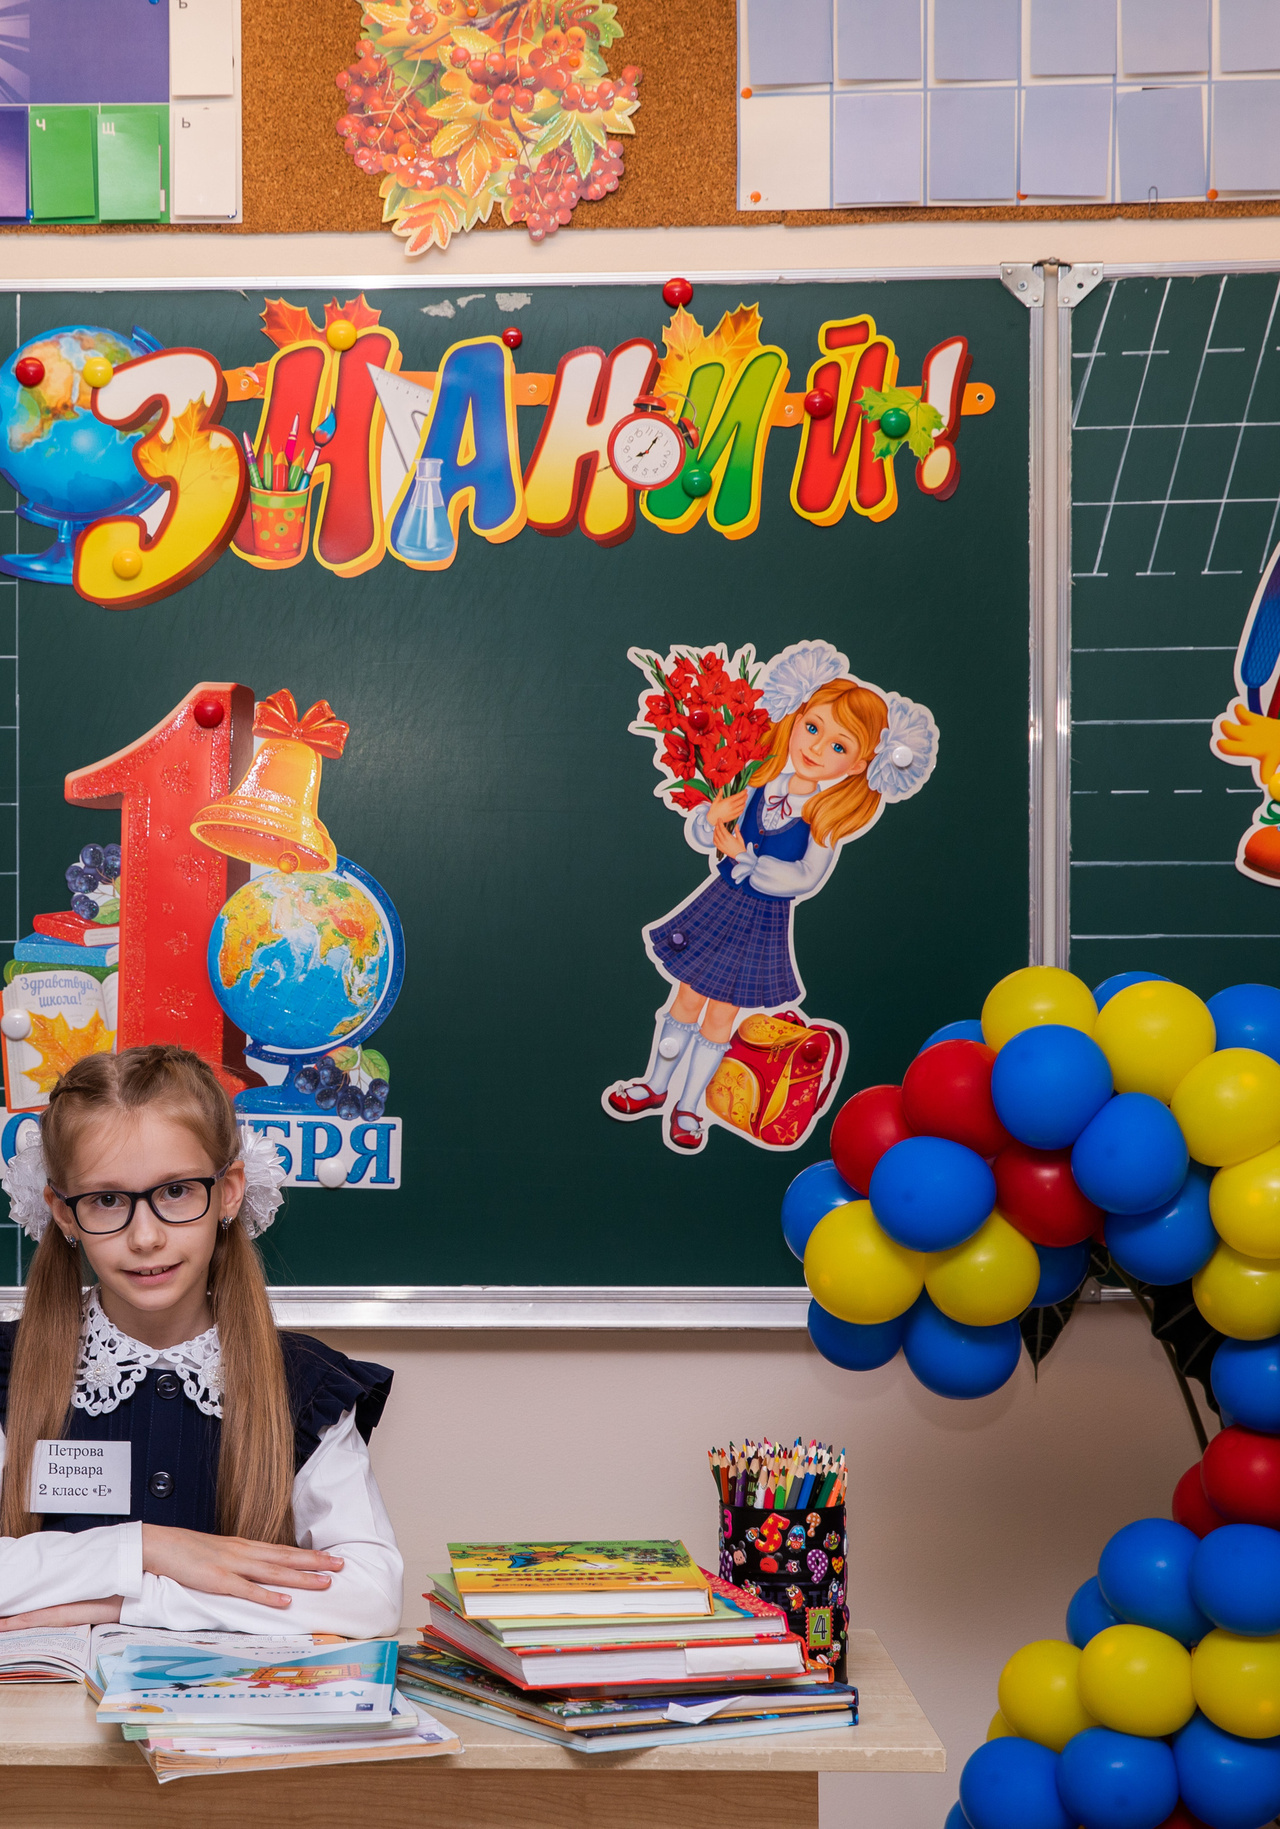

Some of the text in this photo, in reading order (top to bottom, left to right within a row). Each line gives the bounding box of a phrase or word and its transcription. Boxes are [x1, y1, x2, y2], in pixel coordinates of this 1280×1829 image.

[35, 118, 46, 131] Ч
[101, 121, 116, 136] Щ
[181, 116, 191, 129] Ь
[634, 428, 643, 438] 10
[645, 425, 654, 436] 11
[627, 435, 634, 443] 9
[623, 445, 630, 454] 8
[663, 450, 671, 459] 2
[72, 315, 973, 611] ЗНАНИЙ!
[625, 455, 633, 463] 7
[660, 460, 668, 468] 3
[631, 464, 638, 473] 6
[641, 467, 649, 476] 5
[64, 681, 265, 1100] 1
[20, 974, 98, 996] Здравствуй,
[38, 991, 82, 1008] школа!
[48, 1443, 104, 1459] Петрова
[48, 1462, 103, 1478] Варвара
[38, 1484, 112, 1496] 2 класс «Е»
[755, 1513, 790, 1553] 5
[806, 1549, 829, 1584] 9
[813, 1615, 828, 1640] 4
[129, 1656, 223, 1681] 2
[141, 1689, 365, 1699] Математика
